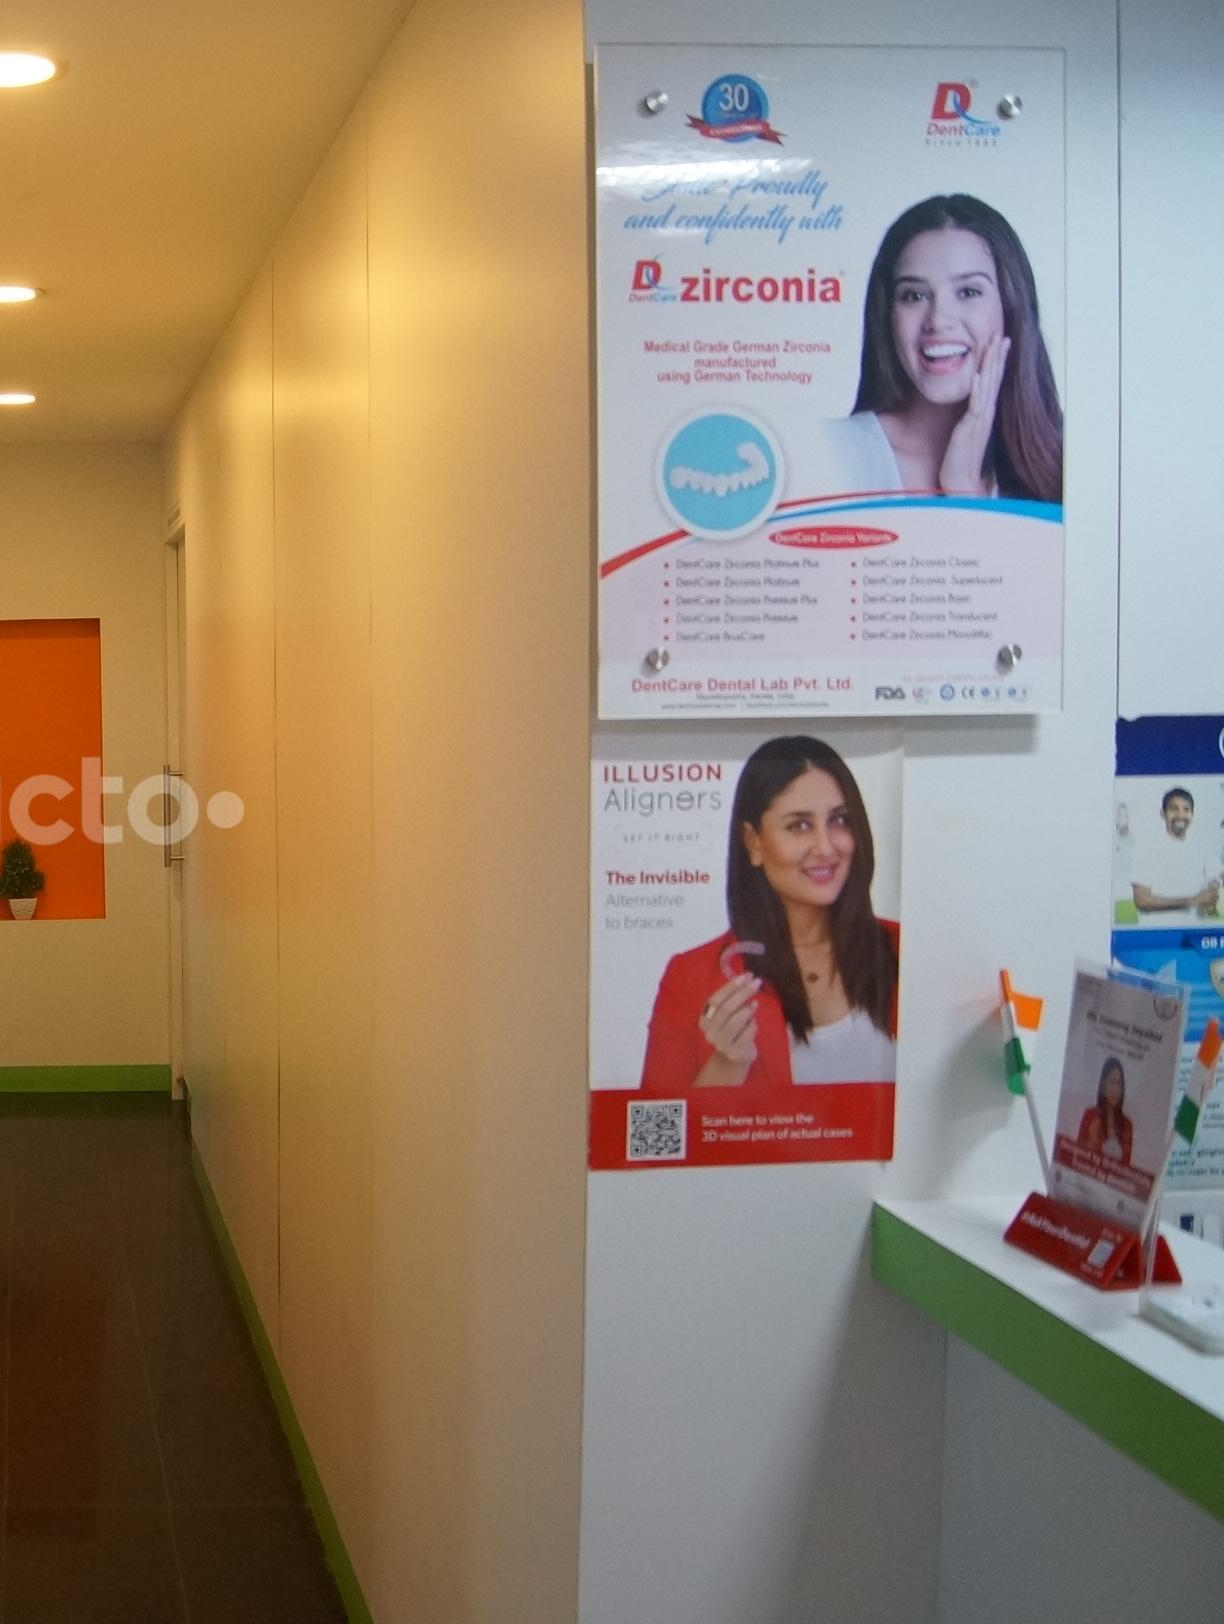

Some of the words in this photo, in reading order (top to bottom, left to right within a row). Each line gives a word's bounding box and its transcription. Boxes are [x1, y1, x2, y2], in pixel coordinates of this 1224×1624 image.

[719, 82, 749, 112] 30
[926, 122, 1001, 136] DentCare
[623, 203, 676, 229] and
[675, 203, 795, 246] confidently
[798, 204, 844, 230] with
[680, 267, 841, 302] zirconia
[628, 293, 676, 303] DentCare
[643, 340, 689, 353] Medical
[693, 340, 729, 352] Grade
[732, 340, 779, 352] German
[782, 340, 831, 352] Zirconia
[694, 357, 776, 368] manufactured
[657, 370, 690, 384] using
[694, 370, 741, 381] German
[746, 369, 813, 384] Technology
[774, 533, 818, 543] DentCare
[820, 533, 855, 543] Zirconia
[676, 558, 720, 568] DentCare
[863, 557, 907, 567] DentCare
[676, 576, 720, 586] DentCare
[863, 575, 907, 585] DentCare
[676, 595, 720, 605] DentCare
[863, 593, 907, 603] DentCare
[676, 613, 720, 623] DentCare
[863, 611, 907, 621] DentCare
[863, 629, 907, 639] DentCare
[631, 679, 703, 693] DentCare
[707, 678, 755, 691] Dental
[761, 677, 788, 691] Lab
[793, 677, 822, 691] Pvt.
[827, 677, 855, 691] Ltd.
[875, 686, 906, 700] FDA
[603, 764, 722, 783] ILLUSION
[603, 787, 723, 817] Aligners
[606, 870, 636, 885] The
[640, 869, 710, 884] Invisible
[605, 893, 684, 908] Alternative
[605, 917, 620, 930] to
[623, 916, 674, 930] braces
[702, 1115, 728, 1128] Scan
[729, 1114, 753, 1126] here
[755, 1115, 767, 1125] to
[768, 1114, 794, 1125] view
[795, 1113, 814, 1123] the
[702, 1130, 718, 1142] 3D
[719, 1128, 750, 1141] visual
[751, 1129, 774, 1142] plan
[776, 1128, 789, 1139] of
[789, 1127, 822, 1138] actual
[823, 1128, 854, 1138] cases
